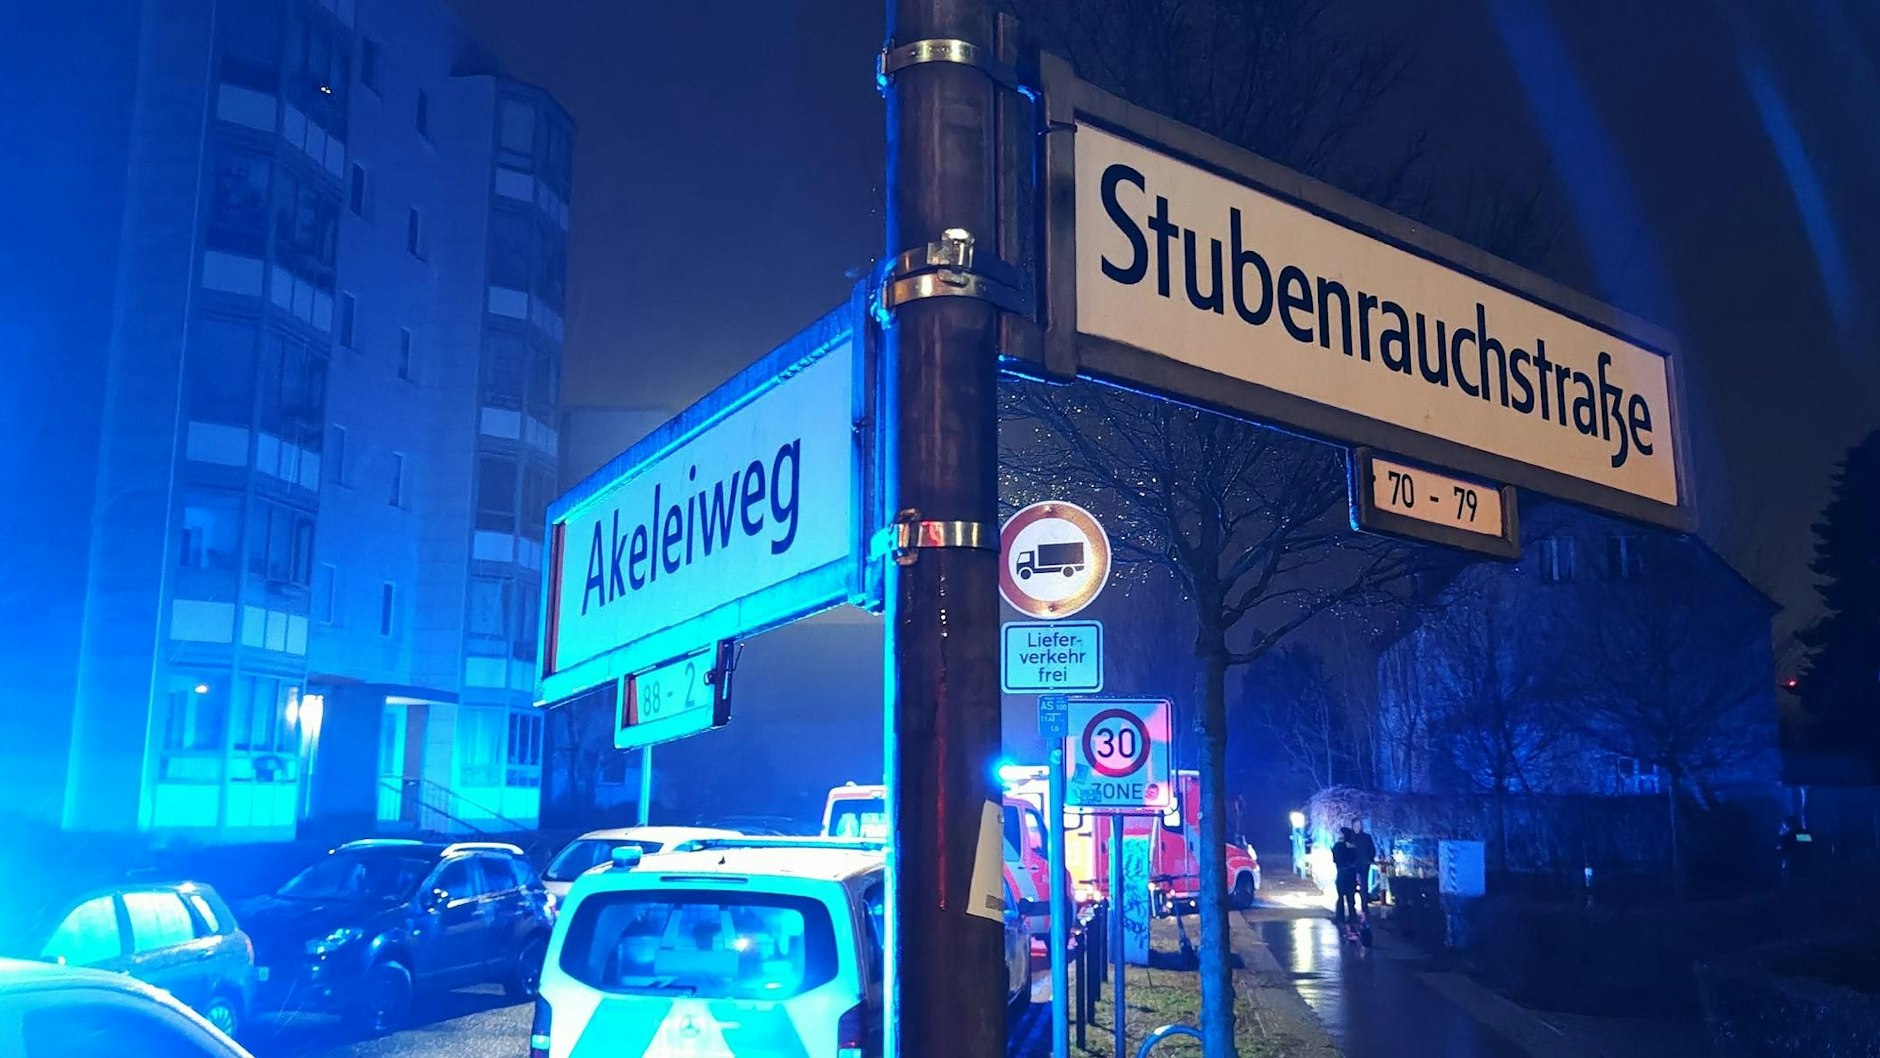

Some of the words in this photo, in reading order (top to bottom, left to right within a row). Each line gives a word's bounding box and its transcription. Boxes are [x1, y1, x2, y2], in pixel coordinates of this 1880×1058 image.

[1100, 163, 1653, 468] Stubenrauchstraße
[1388, 470, 1414, 508] 70
[1453, 486, 1477, 522] 79
[581, 438, 801, 616] Akeleiweg
[1028, 632, 1082, 647] Liefer-
[1020, 649, 1086, 664] verkehr
[643, 681, 660, 716] 88
[685, 661, 696, 708] 2
[1039, 667, 1067, 682] frei
[1041, 701, 1054, 710] AS
[1097, 728, 1135, 758] 30
